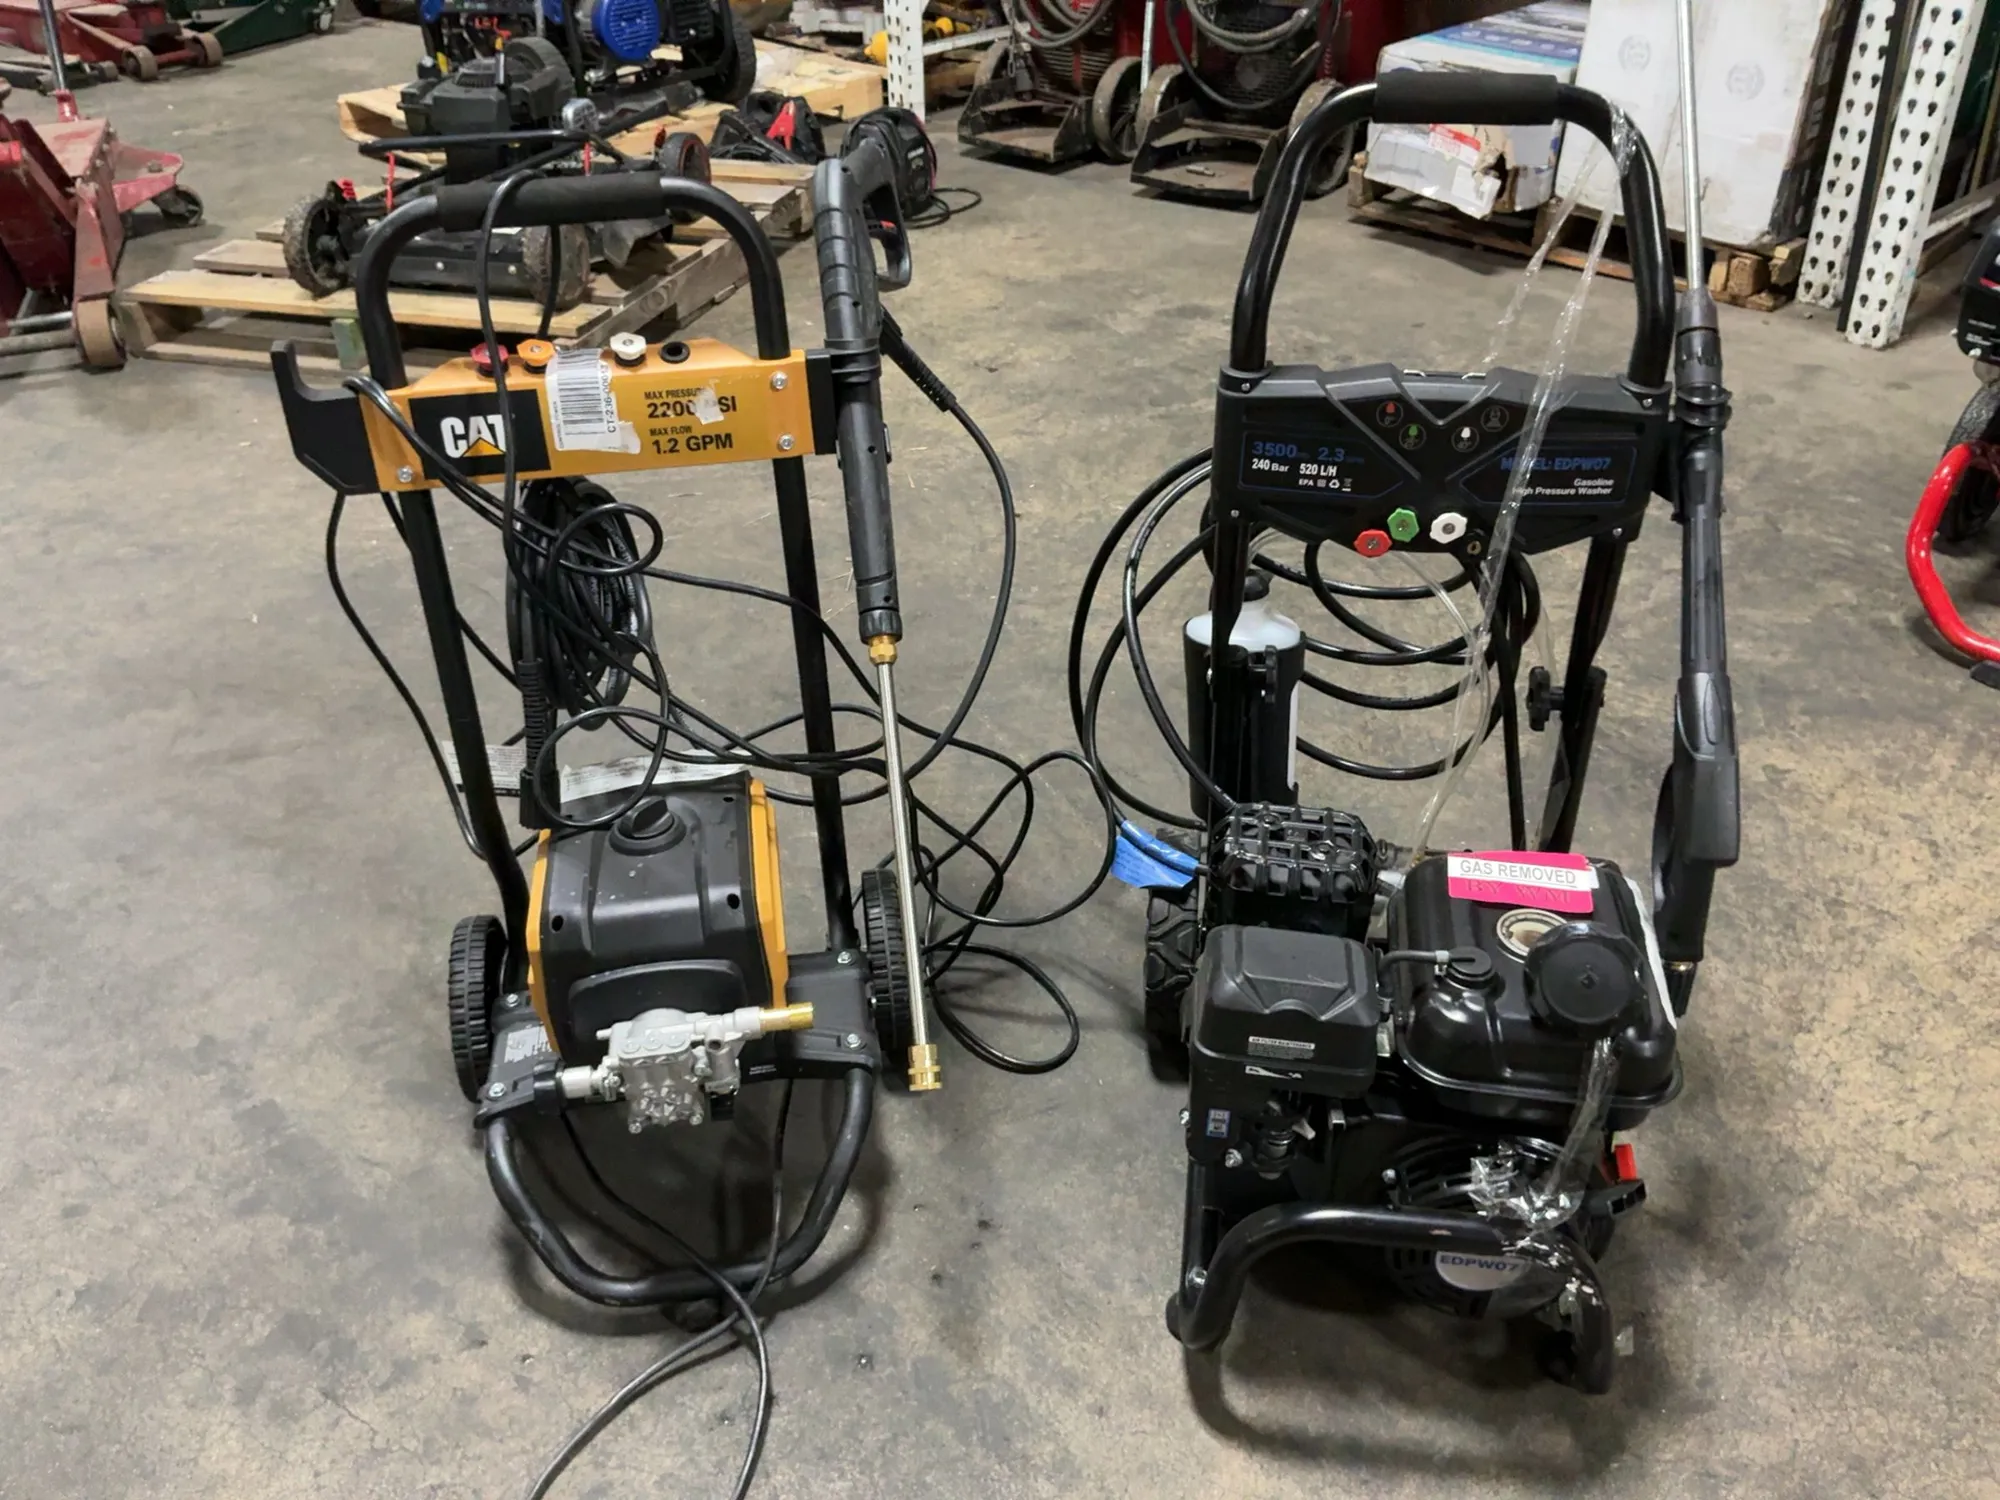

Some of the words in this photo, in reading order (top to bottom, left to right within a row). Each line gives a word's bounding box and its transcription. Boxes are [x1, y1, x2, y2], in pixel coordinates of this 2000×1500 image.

[644, 390, 664, 400] MAX
[665, 387, 706, 399] PRESSU
[440, 414, 507, 458] CAT
[649, 427, 669, 437] MAX
[671, 425, 693, 435] FLOW
[652, 438, 680, 455] 1.2
[686, 433, 734, 452] GPM
[1252, 441, 1298, 458] 3500
[1317, 447, 1346, 462] 2.3
[1252, 458, 1271, 470] 240
[1271, 463, 1290, 472] Bar
[1299, 463, 1319, 475] 520
[1320, 465, 1338, 477] L/H
[1298, 479, 1315, 487] EPA
[1535, 487, 1577, 496] Pressure
[1578, 487, 1613, 495] Washer
[1573, 478, 1615, 487] Gasoline
[1460, 860, 1493, 875] GAS
[1498, 863, 1577, 885] REMOVED
[1440, 1254, 1520, 1272] EDPW07
